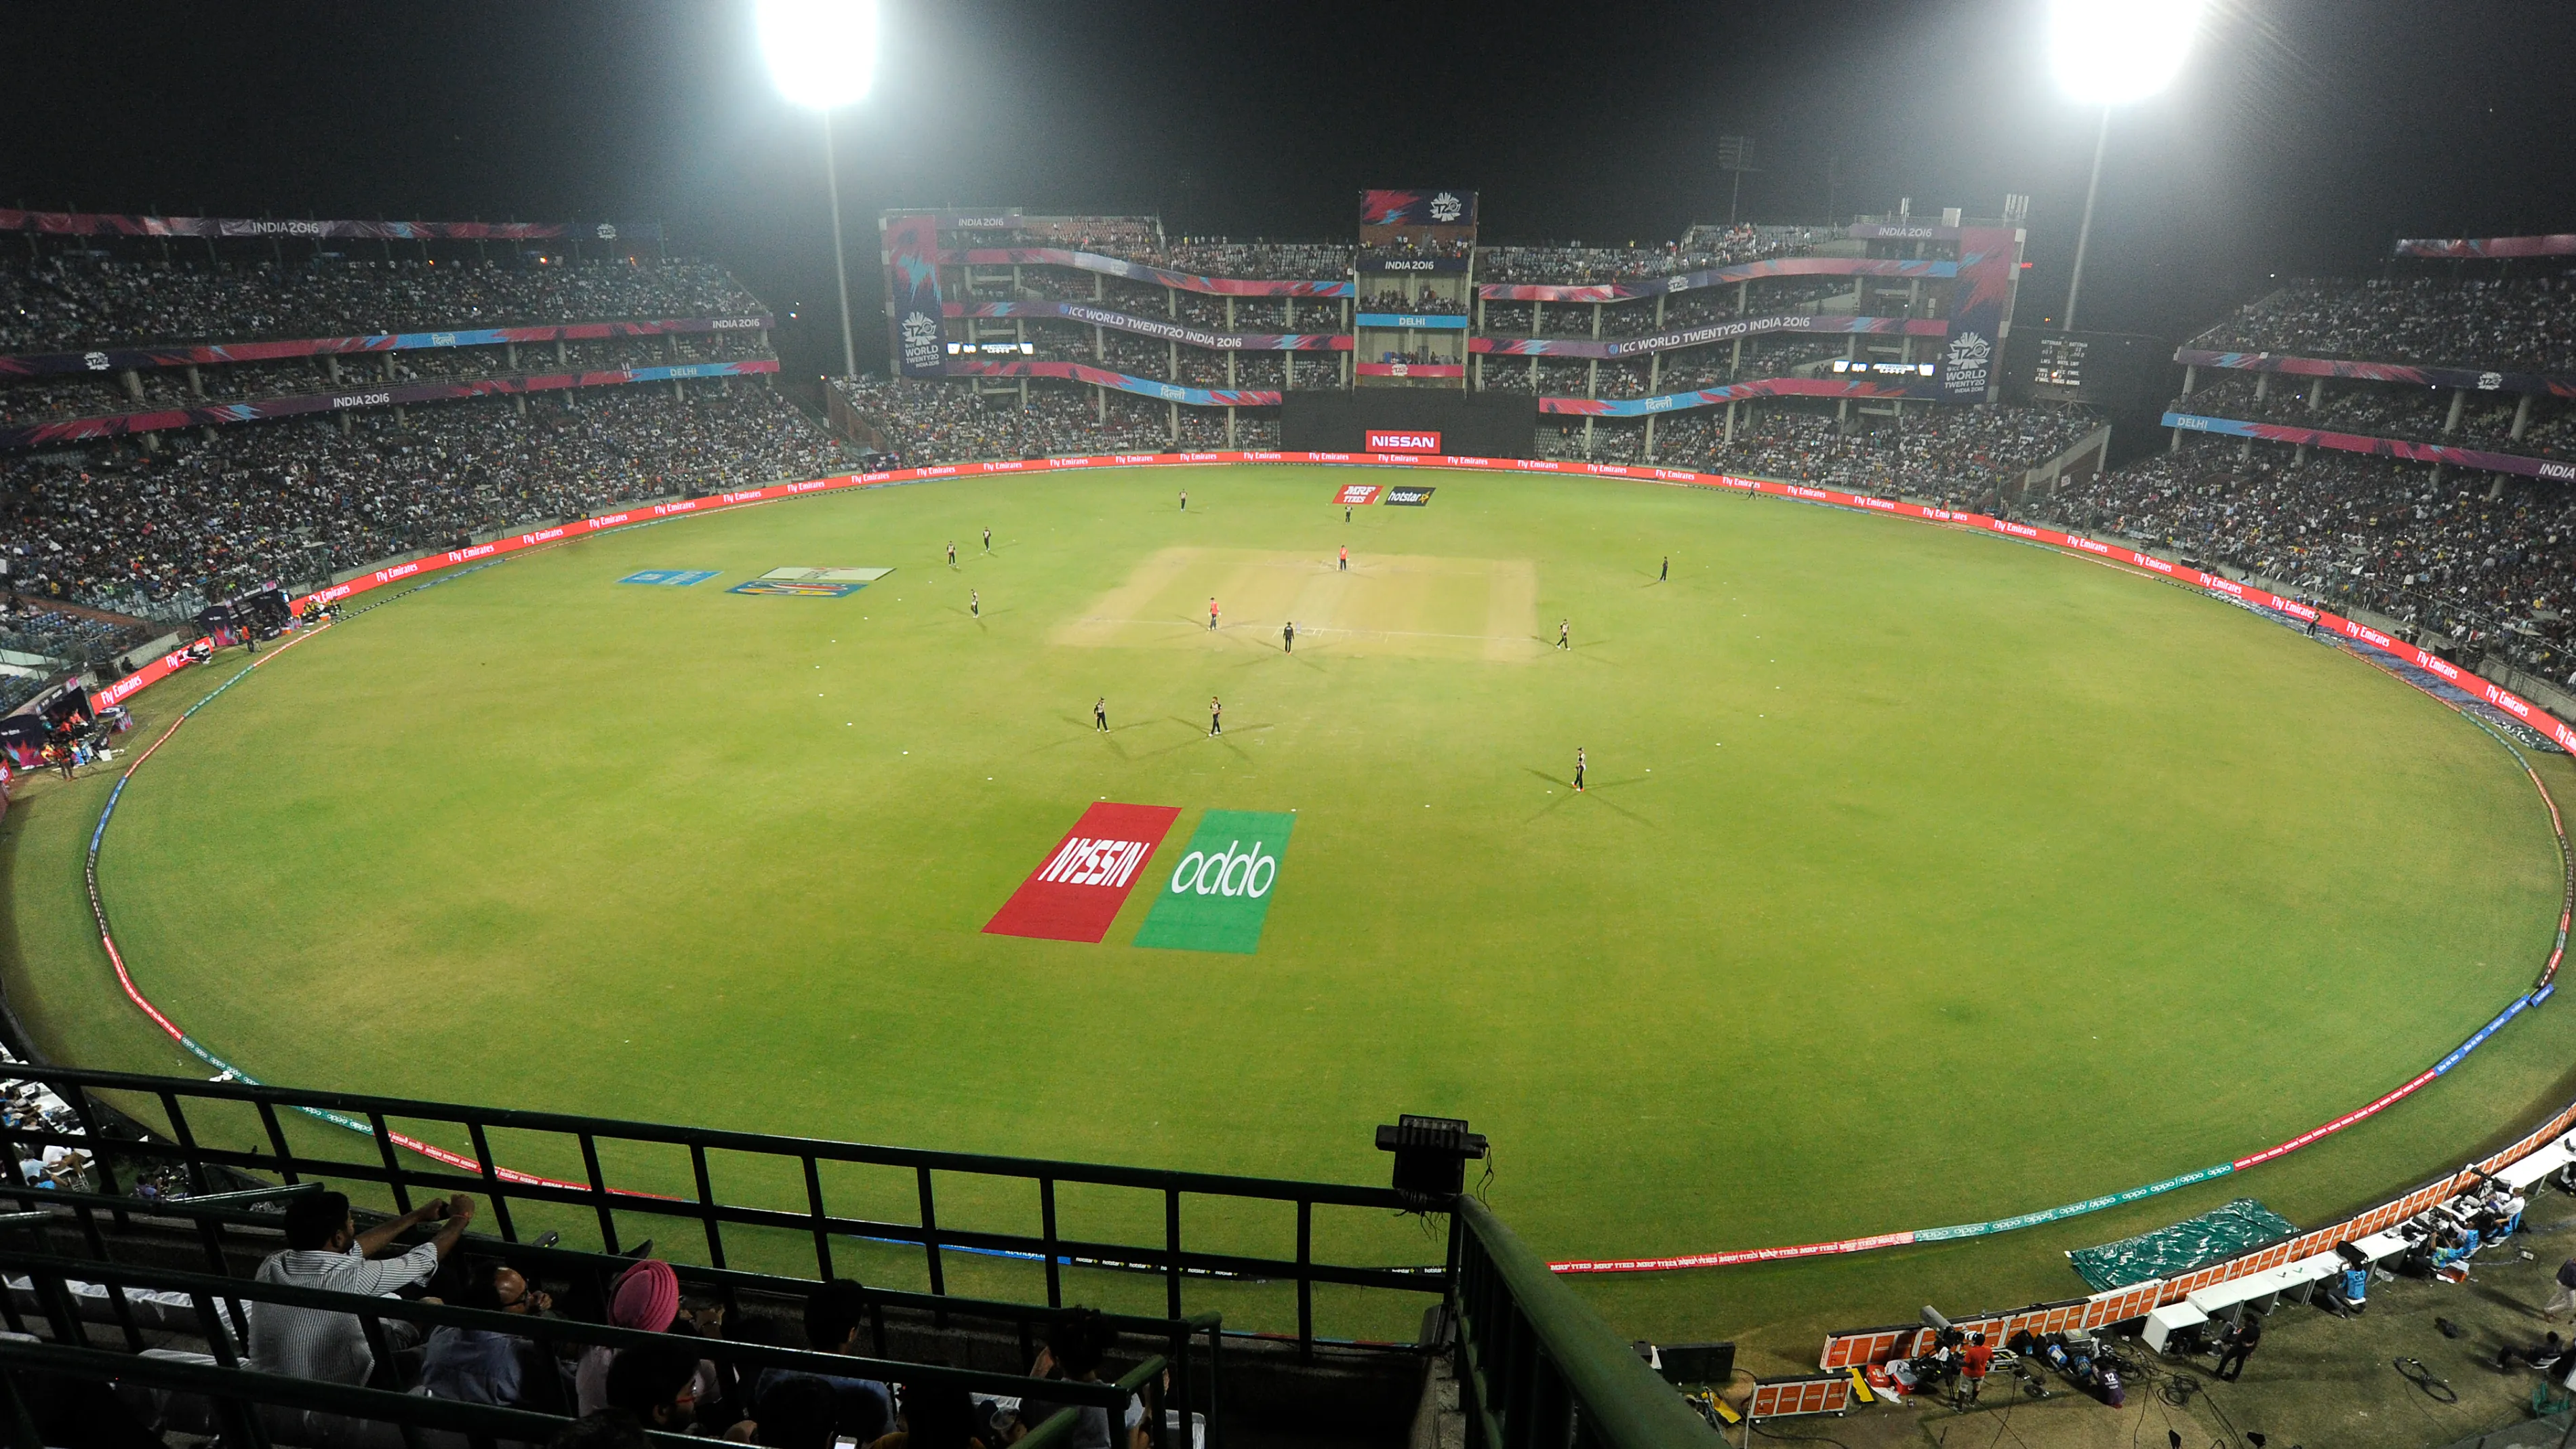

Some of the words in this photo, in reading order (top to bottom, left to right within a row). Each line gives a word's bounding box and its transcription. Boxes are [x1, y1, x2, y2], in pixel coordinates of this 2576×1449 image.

[959, 218, 982, 226] INDIA
[984, 218, 1003, 226] 2016
[1878, 228, 1906, 236] INDIA
[1908, 228, 1932, 237] 2016
[1385, 261, 1410, 270] INDIA
[1412, 261, 1434, 269] 2016
[712, 319, 739, 329] INDIA
[740, 318, 760, 327] 2016
[1068, 306, 1085, 317] ICC
[1086, 310, 1124, 325] WORLD
[1127, 319, 1184, 338] TWENTY20
[1186, 331, 1214, 345] INDIA
[1217, 338, 1241, 347] 2016
[1398, 317, 1425, 325] DELHI
[432, 333, 455, 346] दिल्ली
[1619, 341, 1636, 354] ICC
[1638, 335, 1680, 349] WORLD
[1683, 323, 1746, 343] TWENTY20
[1750, 318, 1781, 331] INDIA
[1782, 317, 1810, 327] 2016
[905, 345, 938, 356] WORLD
[906, 354, 940, 363] TWENTY20
[670, 366, 697, 377] DELHI
[1946, 370, 1986, 381] WORLD
[1945, 380, 1985, 389] TWENTY20
[1161, 385, 1185, 400] दिल्ली
[334, 396, 363, 407] INDIA
[365, 393, 389, 405] 2016
[1645, 395, 1672, 410] दिल्ली
[2177, 417, 2208, 429] DELHI
[1372, 436, 1434, 448] NISSAN
[1050, 458, 1060, 467] Fly
[1062, 457, 1088, 466] Emirates
[1116, 455, 1125, 464] Fly
[1127, 455, 1153, 463] Emirates
[1180, 453, 1190, 462] Fly
[1244, 452, 1253, 460] Fly
[1309, 453, 1319, 461] Fly
[1378, 453, 1388, 462] Fly
[1390, 455, 1418, 463] Emirates
[1448, 456, 1458, 465] Fly
[984, 463, 994, 471] Fly
[996, 461, 1022, 470] Emirates
[1518, 460, 1527, 468] Fly
[1529, 461, 1558, 469] Emirates
[1587, 464, 1598, 472] Fly
[1599, 466, 1627, 474] Emirates
[917, 468, 927, 477] Fly
[928, 466, 955, 475] Emirates
[1655, 469, 1666, 478] Fly
[1668, 472, 1694, 481] Emirates
[2539, 464, 2576, 478] INDIA
[851, 475, 862, 484] Fly
[863, 472, 889, 482] Emirates
[1723, 476, 1733, 485] Fly
[787, 484, 798, 493] Fly
[799, 480, 824, 490] Emirates
[1344, 486, 1375, 495] MRF
[1788, 485, 1798, 494] Fly
[1800, 487, 1826, 498] Emirates
[723, 494, 734, 504] Fly
[735, 490, 761, 500] Emirates
[1388, 491, 1420, 502] hotstar
[1854, 495, 1865, 506] Fly
[1866, 497, 1894, 510] Emirates
[655, 505, 666, 515] Fly
[667, 501, 695, 512] Emirates
[1923, 507, 1934, 517] Fly
[589, 518, 600, 529] Fly
[601, 514, 627, 526] Emirates
[1994, 520, 2005, 531] Fly
[2007, 523, 2036, 536] Emirates
[523, 533, 534, 544] Fly
[535, 528, 563, 542] Emirates
[2068, 535, 2078, 546] Fly
[2079, 539, 2107, 553] Emirates
[449, 552, 461, 562] Fly
[462, 544, 494, 558] Emirates
[2134, 553, 2145, 564] Fly
[2146, 556, 2171, 572] Emirates
[376, 571, 388, 582] Fly
[389, 563, 418, 578] Emirates
[2200, 573, 2211, 586] Fly
[2213, 577, 2242, 594] Emirates
[2272, 596, 2284, 609] Fly
[2285, 600, 2315, 617] Emirates
[2346, 621, 2359, 636] Fly
[2360, 627, 2390, 647] Emirates
[165, 654, 178, 669] Fly
[2417, 651, 2430, 666] Fly
[2430, 657, 2457, 679] Emirates
[101, 689, 115, 705] Fly
[113, 675, 142, 697] Emirates
[2486, 685, 2498, 702] Fly
[2499, 693, 2529, 717] Emirates
[2555, 724, 2568, 740] Fly
[1037, 838, 1150, 887] NISSAN
[182, 1037, 194, 1048] oppo
[195, 1047, 207, 1058] oppo
[210, 1057, 225, 1068] oppo
[327, 1114, 347, 1124] oppo
[500, 1171, 518, 1180] NISSAN
[2122, 1189, 2147, 1199] oppo
[2150, 1181, 2175, 1191] oppo
[2180, 1172, 2204, 1183] oppo
[2207, 1165, 2230, 1175] oppo
[1993, 1220, 2021, 1229] oppo
[2105, 1372, 2116, 1382] 12
